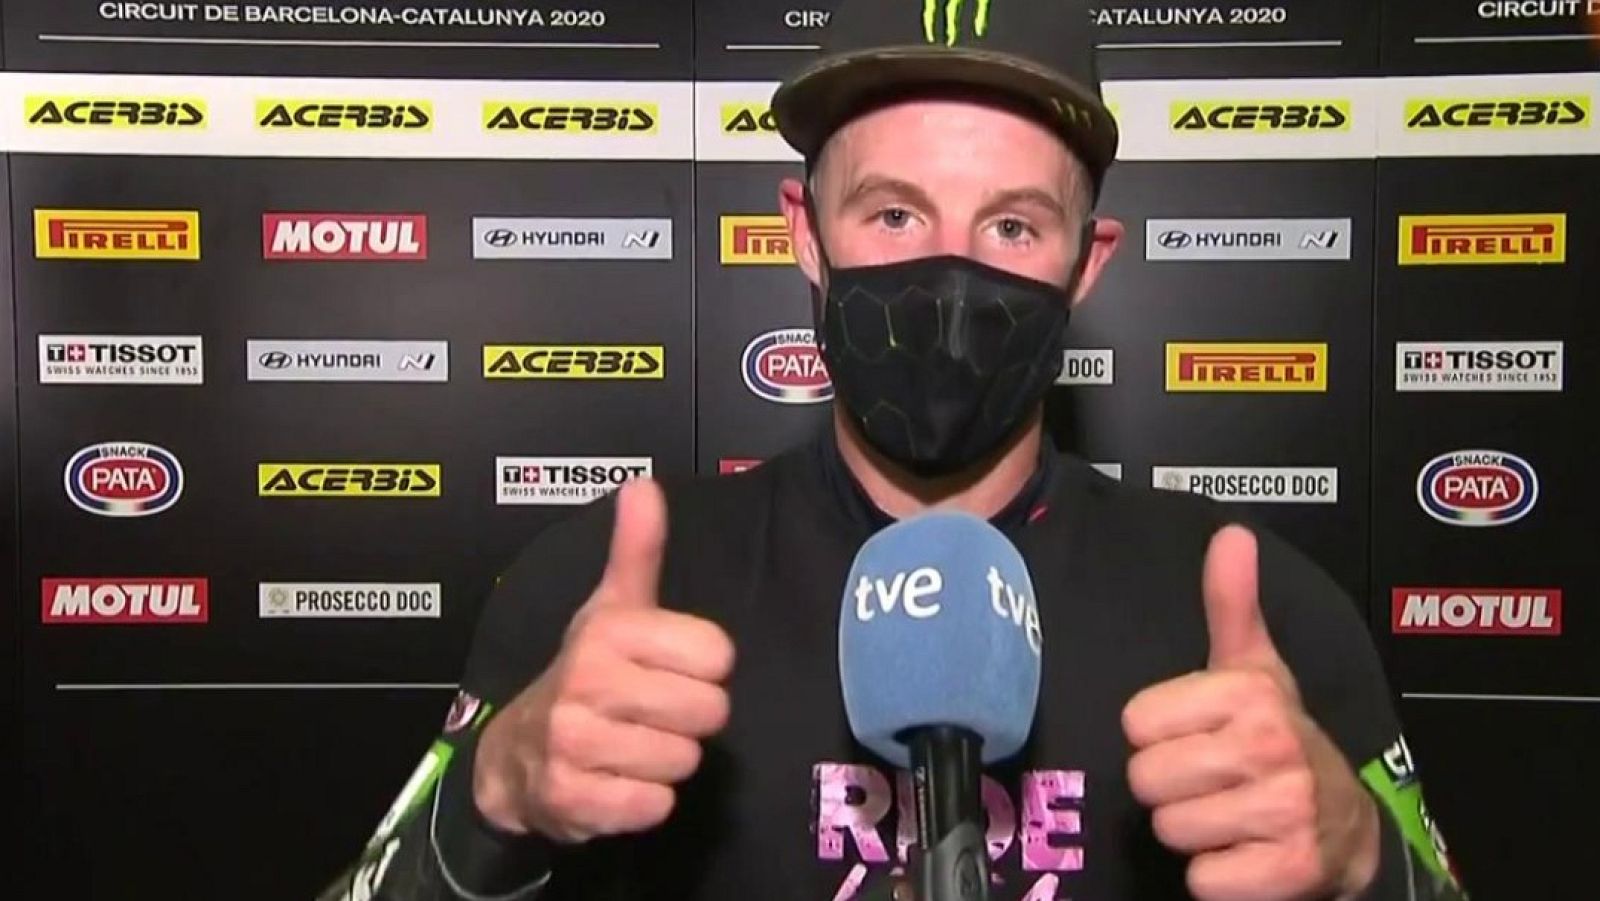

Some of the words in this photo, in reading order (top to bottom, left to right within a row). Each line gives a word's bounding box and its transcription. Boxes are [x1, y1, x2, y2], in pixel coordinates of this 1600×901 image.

[100, 3, 198, 21] CIRCUIT
[205, 5, 239, 22] DE
[244, 5, 544, 27] BARCELONA-CATALUNYA
[550, 10, 605, 27] 2020
[1230, 7, 1287, 24] 2020
[1478, 0, 1580, 18] CIRCUIT
[48, 219, 189, 250] PIRELLI
[271, 220, 421, 253] MOTUL
[522, 231, 605, 246] HYUNDAI
[1196, 232, 1281, 247] HYUNDAI
[1411, 223, 1555, 255] PIRELLI
[776, 332, 817, 345] SNAC
[88, 344, 196, 363] TISSOT
[297, 354, 381, 368] HYUNDAI
[1446, 351, 1557, 370] TISSOT
[86, 366, 135, 375] WATCHES
[140, 366, 169, 375] SINCE
[767, 354, 829, 378] PATA
[1069, 357, 1104, 378] DOC
[1178, 352, 1316, 382] PIRELLI
[1442, 373, 1492, 382] WATCHES
[1497, 373, 1528, 382] SINCE
[102, 446, 147, 458] SNACK
[1454, 455, 1502, 467] SNACK
[91, 467, 153, 491] PATA
[543, 465, 646, 484] TISSOT
[1189, 474, 1286, 497] PROSECCO
[1292, 475, 1329, 497] DOC
[1444, 475, 1506, 500] PATA
[50, 584, 201, 616] MOTUL
[295, 590, 391, 612] PROSECCO
[396, 590, 433, 612] DOC
[855, 566, 943, 621] tve
[985, 565, 1044, 656] tve
[1400, 594, 1553, 628] MOTUL
